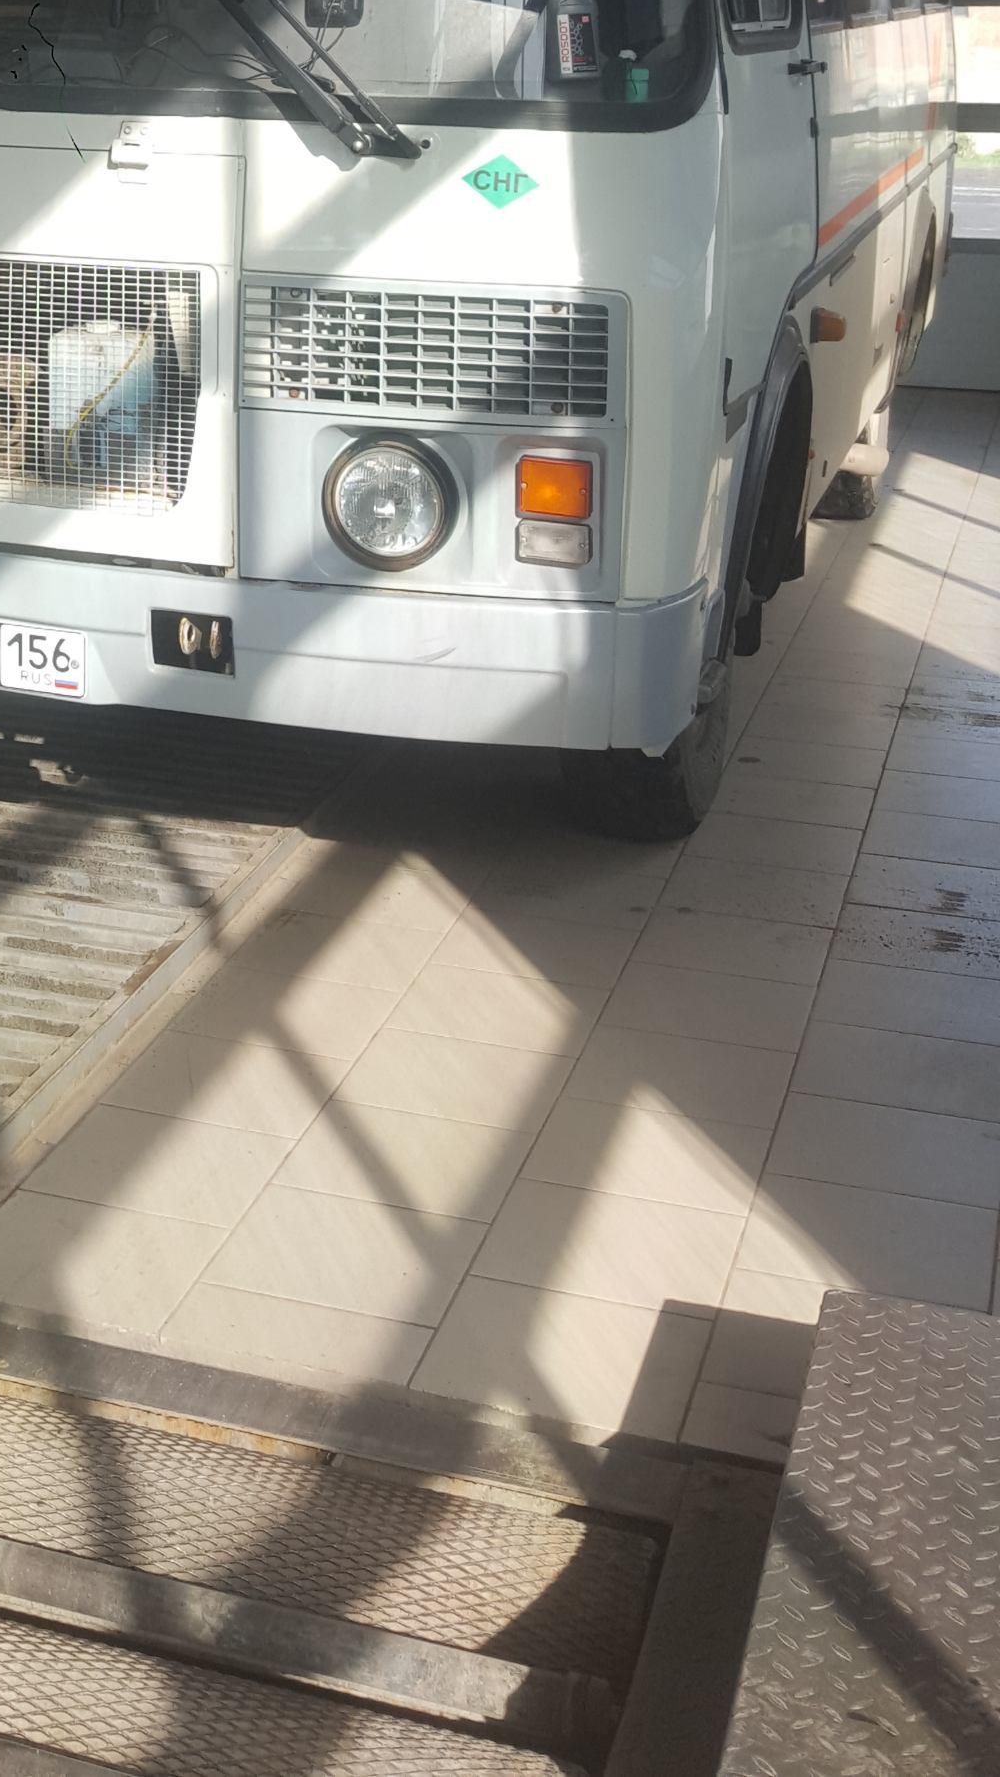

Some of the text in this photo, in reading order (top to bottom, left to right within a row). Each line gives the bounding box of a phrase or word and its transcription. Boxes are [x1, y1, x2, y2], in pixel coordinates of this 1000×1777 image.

[473, 170, 528, 193] СНГ
[7, 632, 70, 673] 156
[20, 670, 53, 686] RUS
